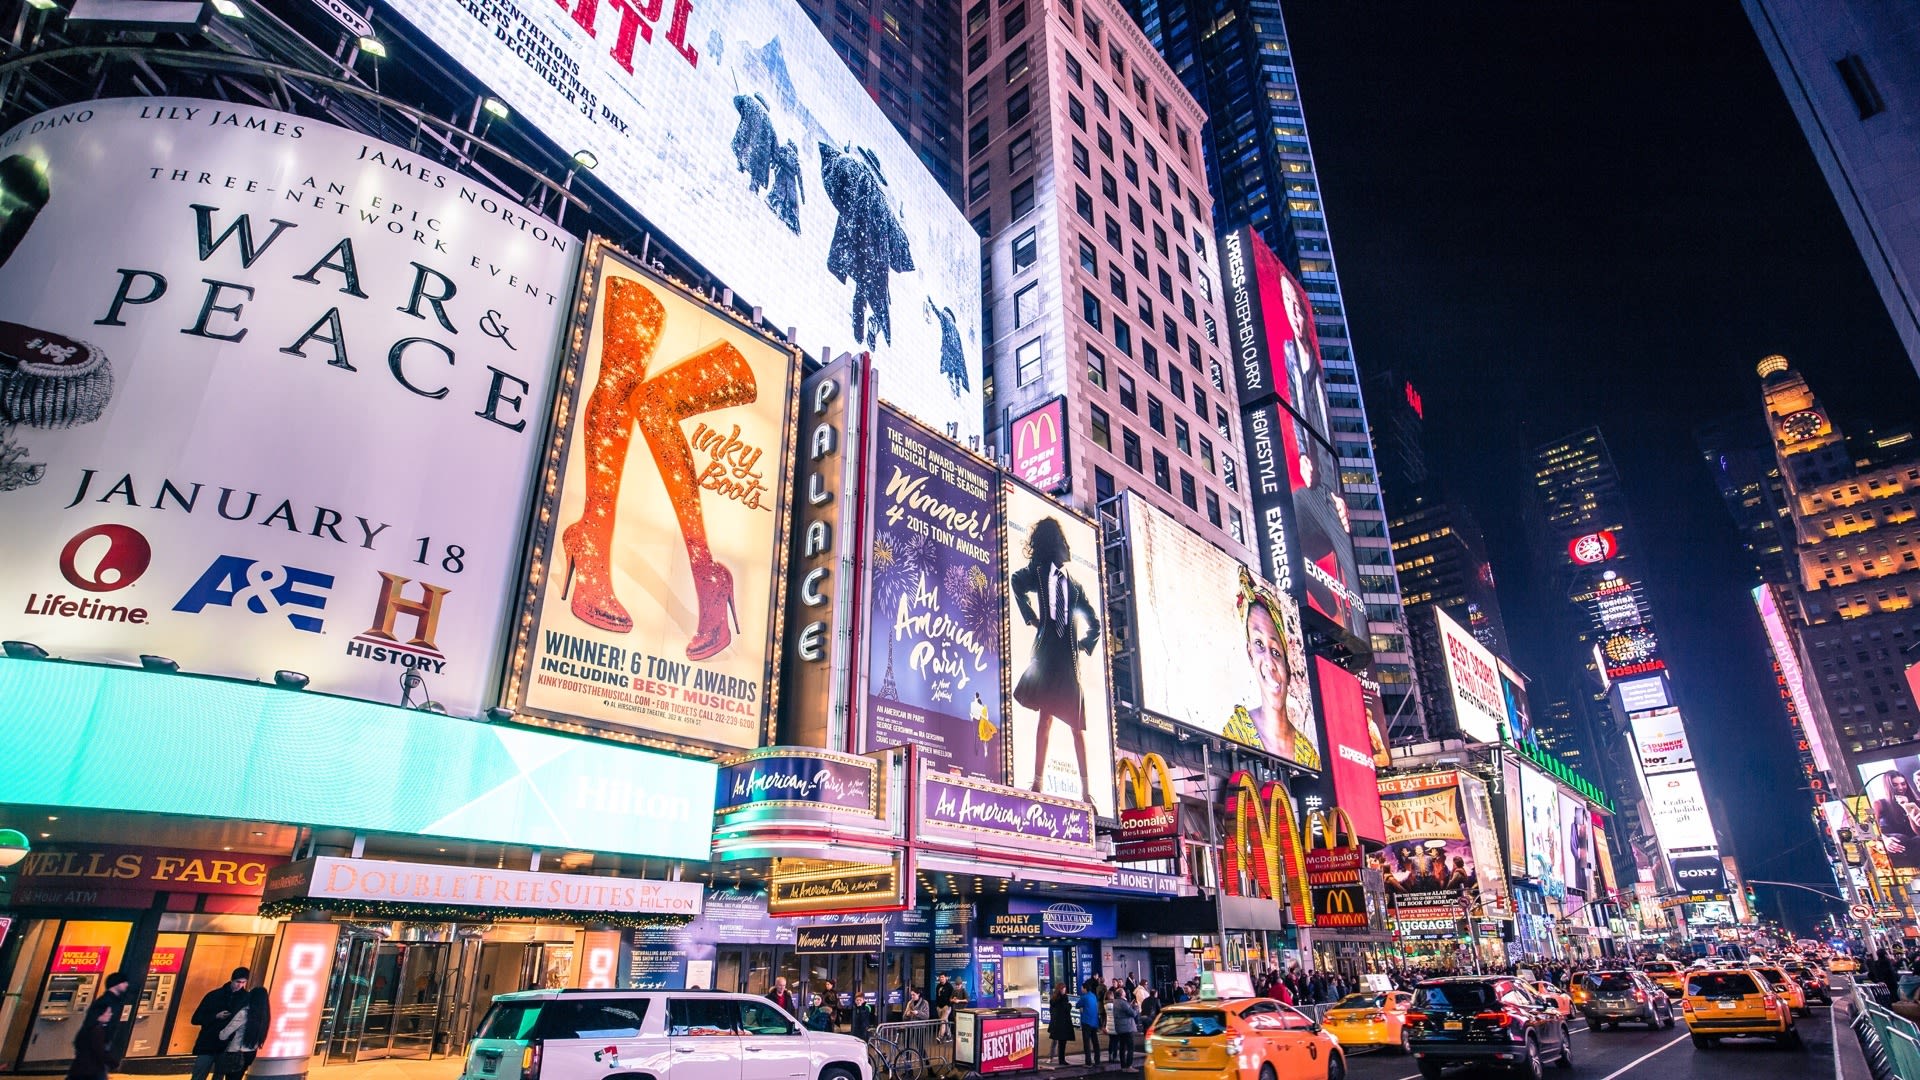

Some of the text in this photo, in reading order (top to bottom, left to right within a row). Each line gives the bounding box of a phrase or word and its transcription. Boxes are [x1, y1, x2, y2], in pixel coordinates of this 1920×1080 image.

[493, 24, 598, 125] DECEMBER 31.
[516, 28, 630, 138] CHRISTMAS DAY.
[30, 106, 305, 139] DANO LILY JAMES
[302, 176, 441, 232] AN EPIC
[357, 144, 568, 252] JAMES NORTON
[150, 167, 558, 306] THREE-NETWORK EVENT
[189, 203, 518, 351] WAR &
[94, 268, 528, 433] PEACE
[1243, 348, 1262, 390] CURRY
[887, 427, 989, 491] THE MOST AWARD-WINNING
[1020, 447, 1055, 470] OPEN
[1252, 409, 1279, 495] #GIVESTYLE
[697, 461, 772, 512] Boots
[891, 443, 987, 501] MUSICAL OF THE SEASON!
[1025, 460, 1051, 482] 24
[798, 378, 838, 661] PALACE
[885, 465, 991, 541] Winner!
[64, 468, 466, 575] JANUARY 18
[886, 505, 990, 565] 4 2015 TONY AWARDS
[1265, 506, 1292, 593] EXPRESS
[171, 554, 335, 634] A&E
[913, 571, 940, 611] An
[24, 593, 149, 625] Lifetime
[894, 593, 987, 671] American
[346, 641, 446, 676] HISTORY
[545, 630, 757, 703] WINNER! 6 TONY AWARDS
[909, 640, 971, 690] Paris
[1607, 660, 1665, 678] TOSHIBA
[537, 673, 650, 706] KINKYBOOTSTHEMUSICAL.COM
[656, 700, 669, 710] FOR
[671, 703, 698, 717] TICKETS
[698, 709, 714, 721] CALL
[540, 657, 755, 716] INCLUDING BEST MUSICAL
[1772, 662, 1799, 727] ERNST
[883, 707, 907, 720] AMERICAN
[912, 713, 925, 724] PARIS
[1644, 756, 1667, 764] HOT
[1653, 744, 1683, 753] DONUTS
[576, 776, 690, 822] Hilton
[732, 773, 745, 798] An
[746, 768, 810, 797] American
[814, 769, 846, 799] Paris
[1400, 778, 1422, 791] FAT
[935, 788, 956, 818] An
[958, 789, 1024, 832] American
[1026, 803, 1059, 838] Paris
[1384, 794, 1444, 809] OMETHING
[1120, 815, 1175, 829] cDonald's
[1122, 826, 1164, 837] Restaurant
[1147, 845, 1172, 853] HOURS
[1306, 852, 1360, 864] McDonald's
[22, 851, 144, 879] WELLS
[152, 855, 267, 887] FARG
[1120, 873, 1177, 892] MONEY ATM
[1678, 868, 1717, 878] SONY
[64, 891, 97, 903] ATM
[638, 897, 693, 910] HILTON
[640, 885, 661, 896] BY
[799, 880, 829, 898] American
[989, 925, 1040, 934] EXCHANGE
[996, 915, 1030, 925] MONEY
[1062, 914, 1093, 923] EXCHANGE
[63, 951, 98, 959] WELLS
[152, 952, 175, 961] ELLS
[798, 931, 828, 948] Winner!
[840, 935, 856, 946] TONY
[857, 934, 881, 945] AWARDS
[981, 1033, 1014, 1062] JERSEY
[1015, 1027, 1035, 1051] BOYS
